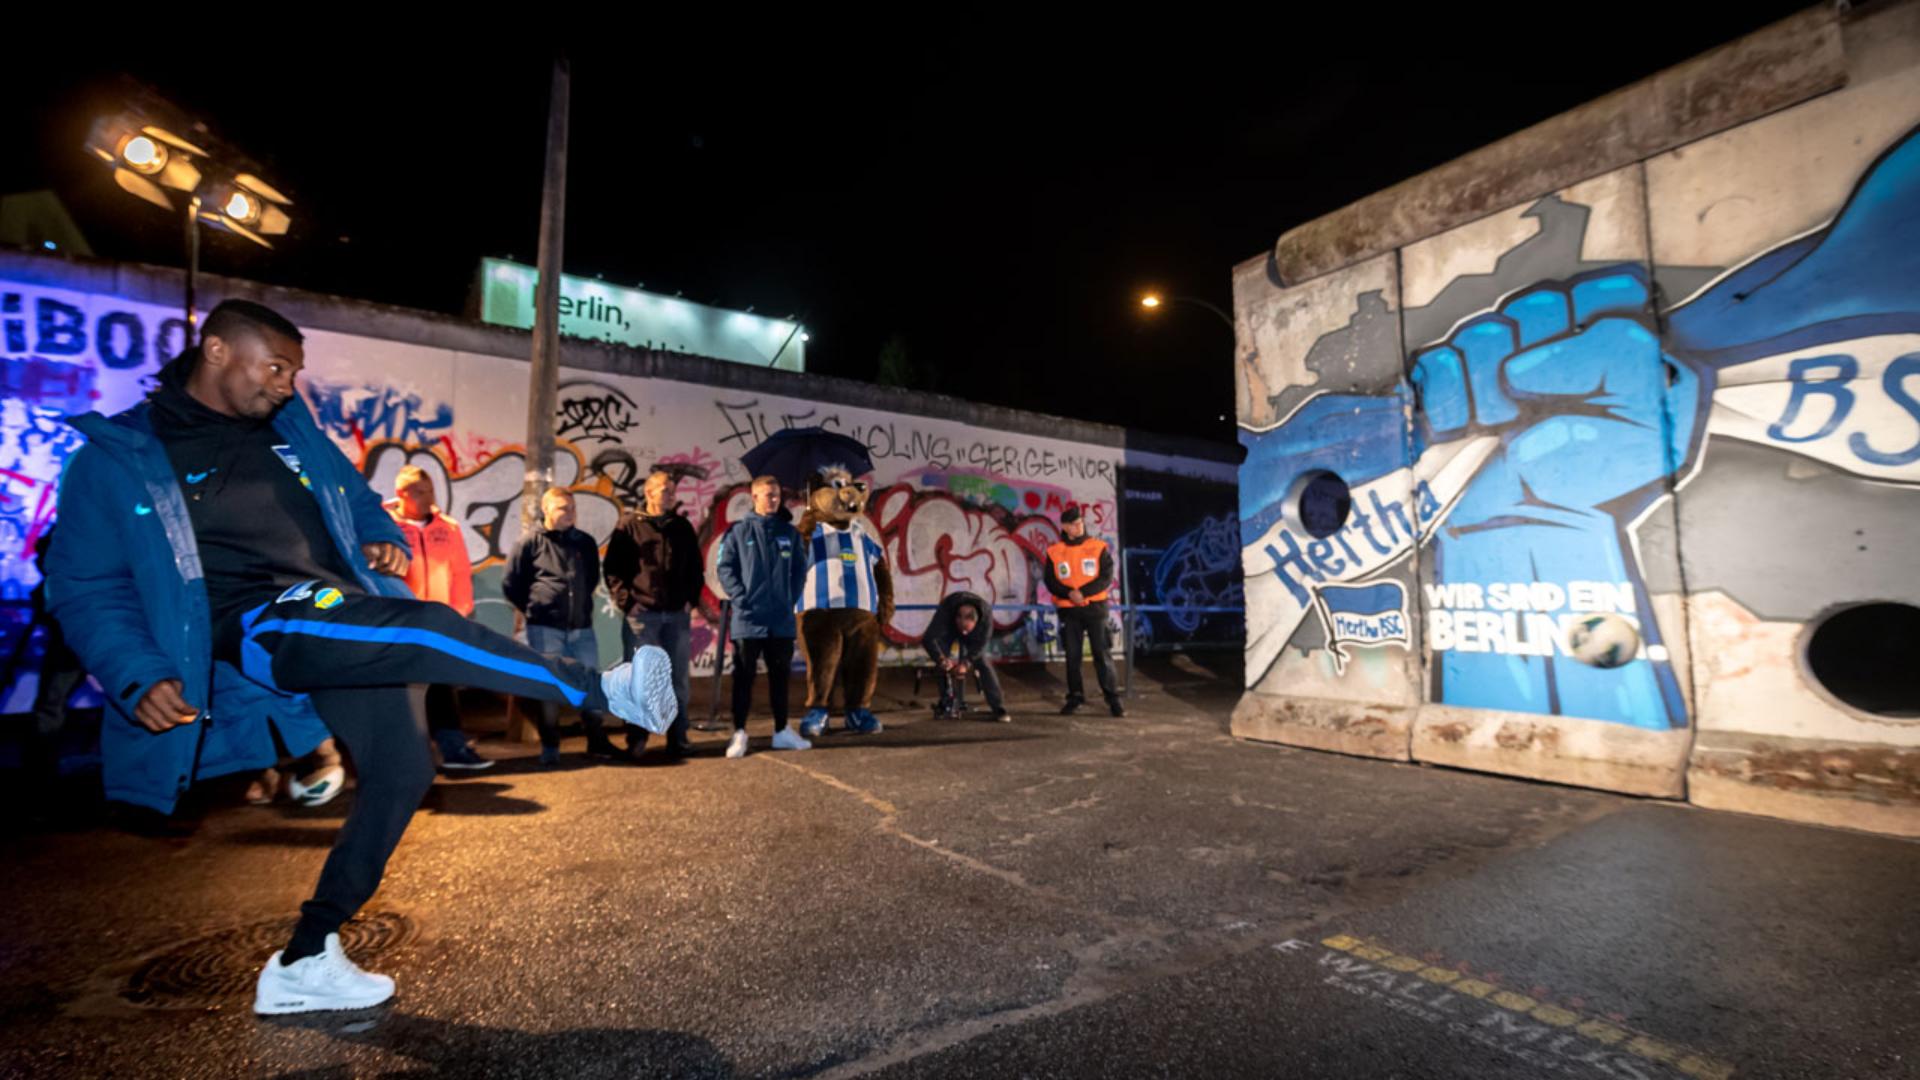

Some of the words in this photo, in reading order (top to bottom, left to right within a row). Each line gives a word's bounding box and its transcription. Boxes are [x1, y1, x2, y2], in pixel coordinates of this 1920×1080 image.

[533, 284, 630, 330] erlin,
[1264, 480, 1442, 609] Hertha
[1425, 583, 1484, 609] WIR
[1487, 581, 1566, 612] SIND
[1567, 580, 1636, 613] EIN
[1428, 609, 1669, 661] BERLIN.
[1319, 951, 1457, 1013] WALL
